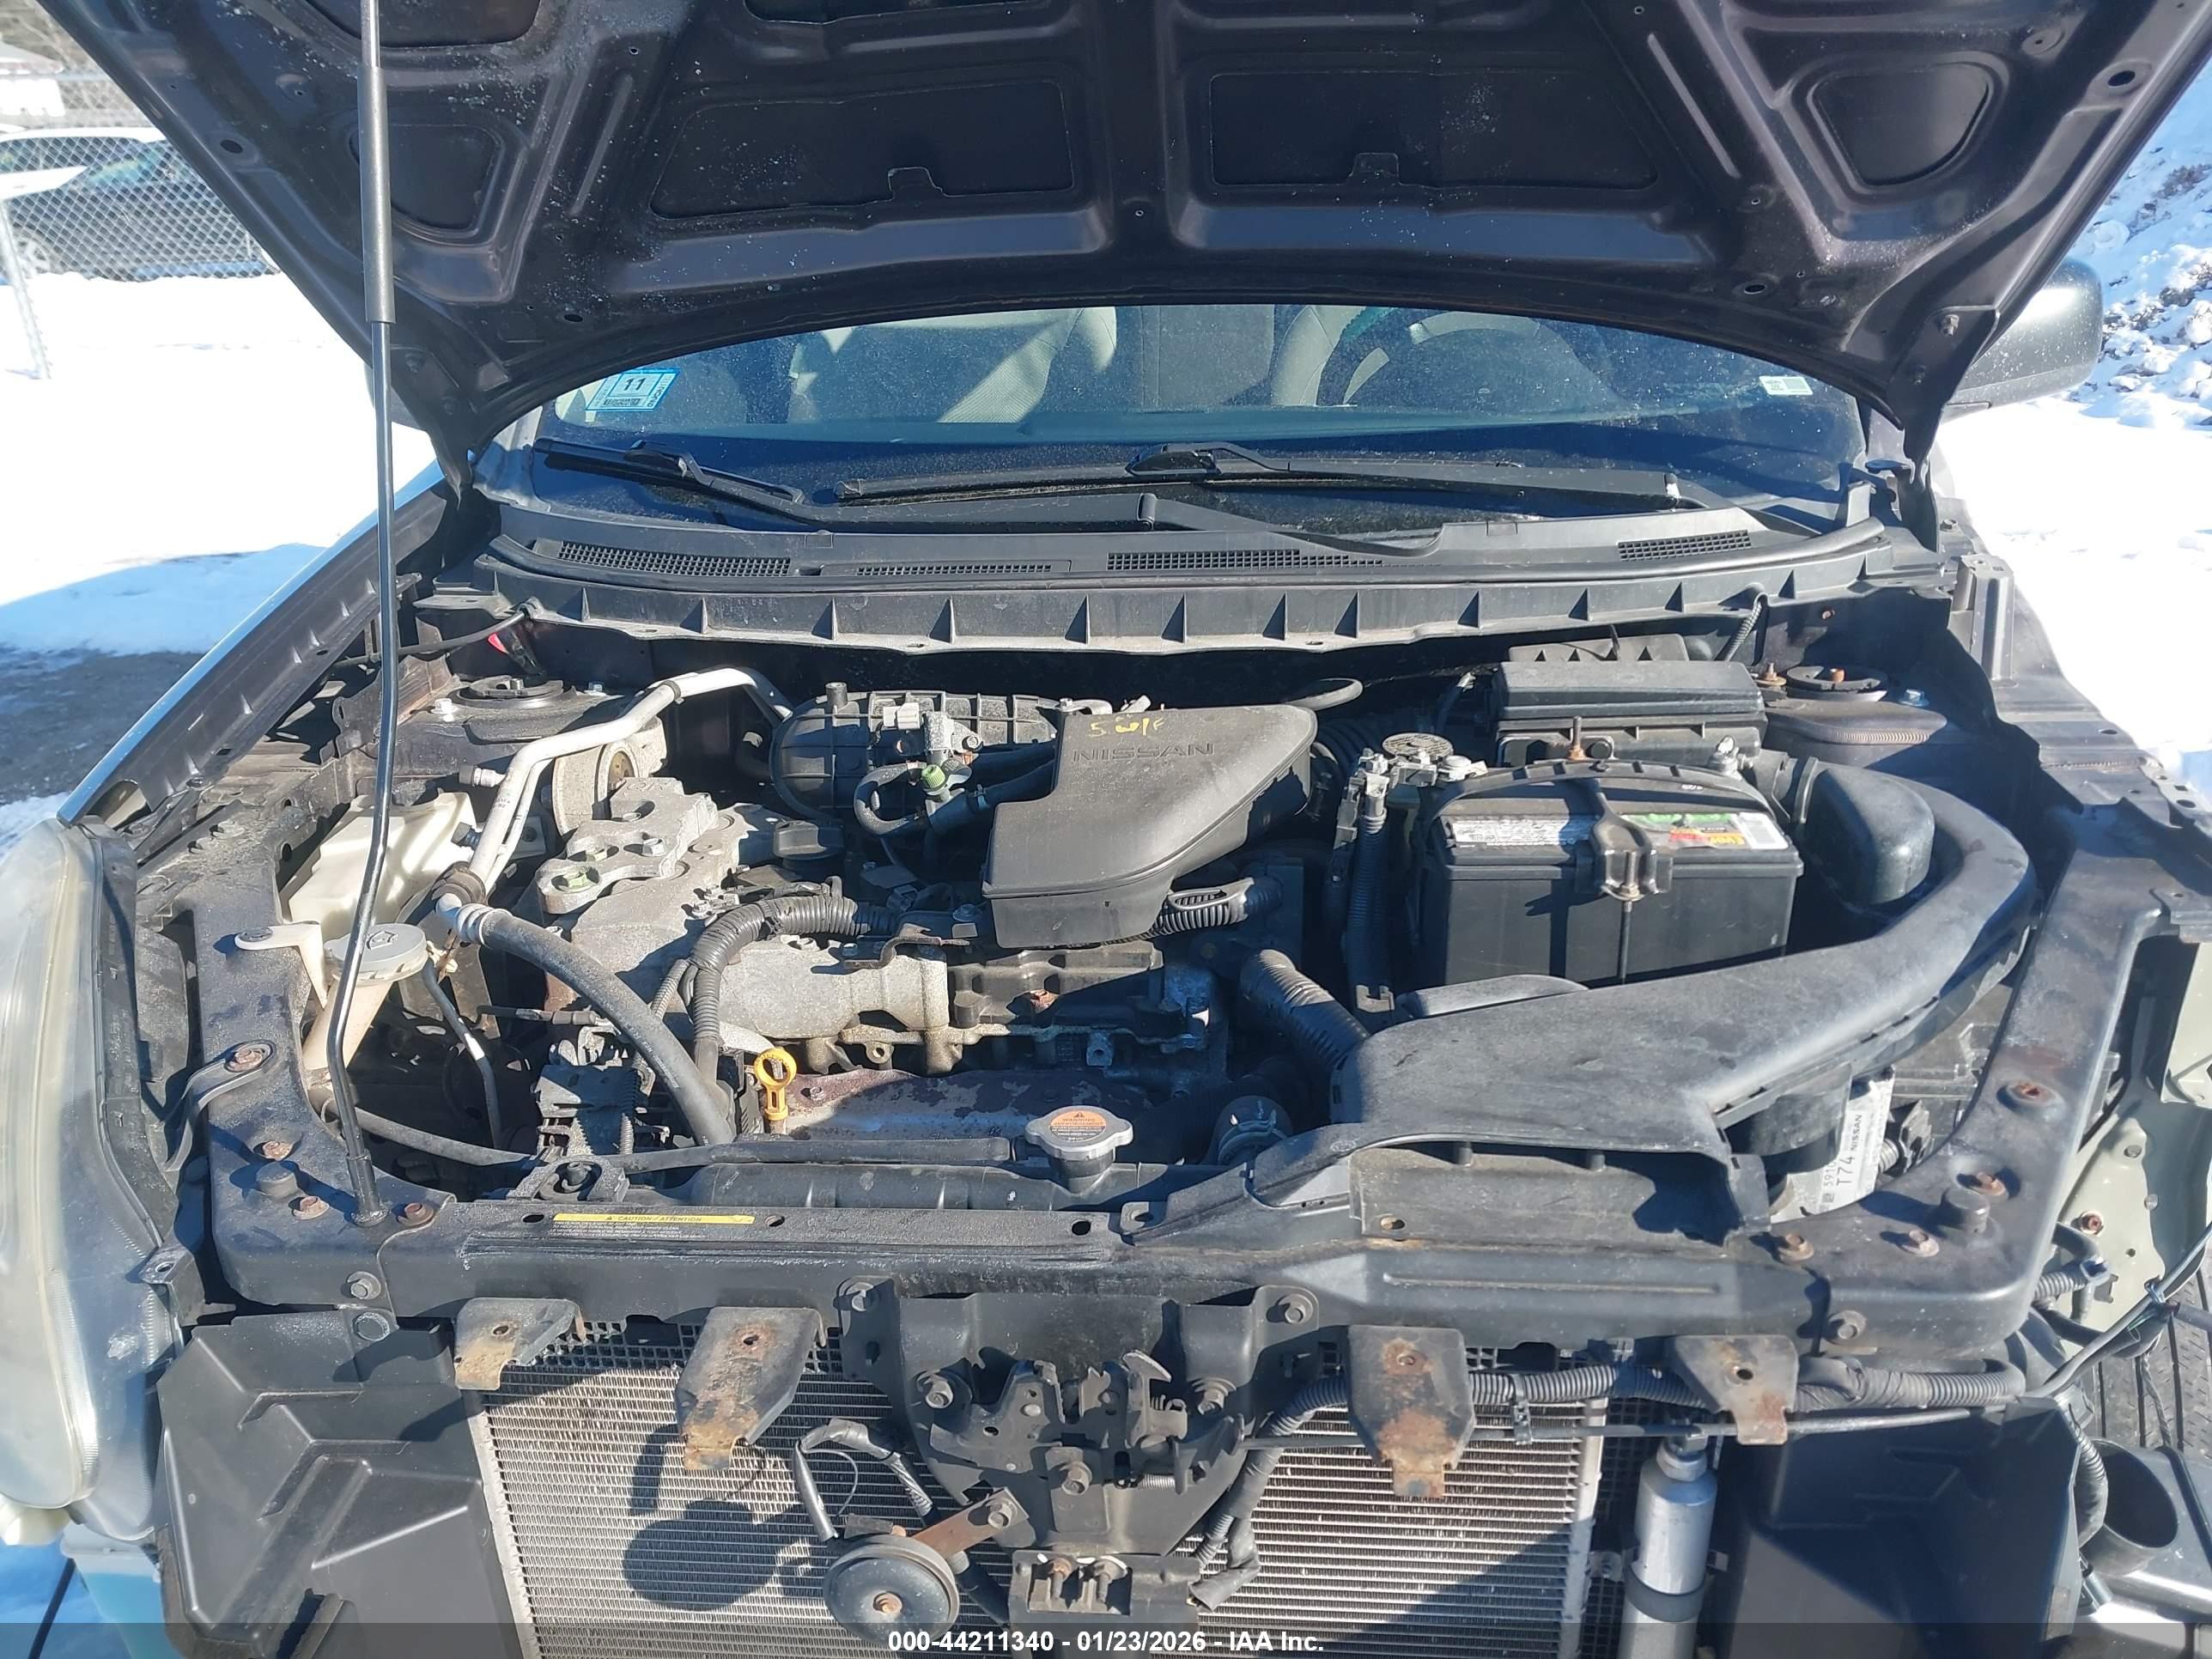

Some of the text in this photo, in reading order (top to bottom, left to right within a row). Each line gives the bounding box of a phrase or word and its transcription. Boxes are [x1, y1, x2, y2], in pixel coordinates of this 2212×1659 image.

[623, 377, 646, 392] 11
[1073, 742, 1215, 762] NISSAN
[1836, 1115, 1863, 1187] T74 NISSAN
